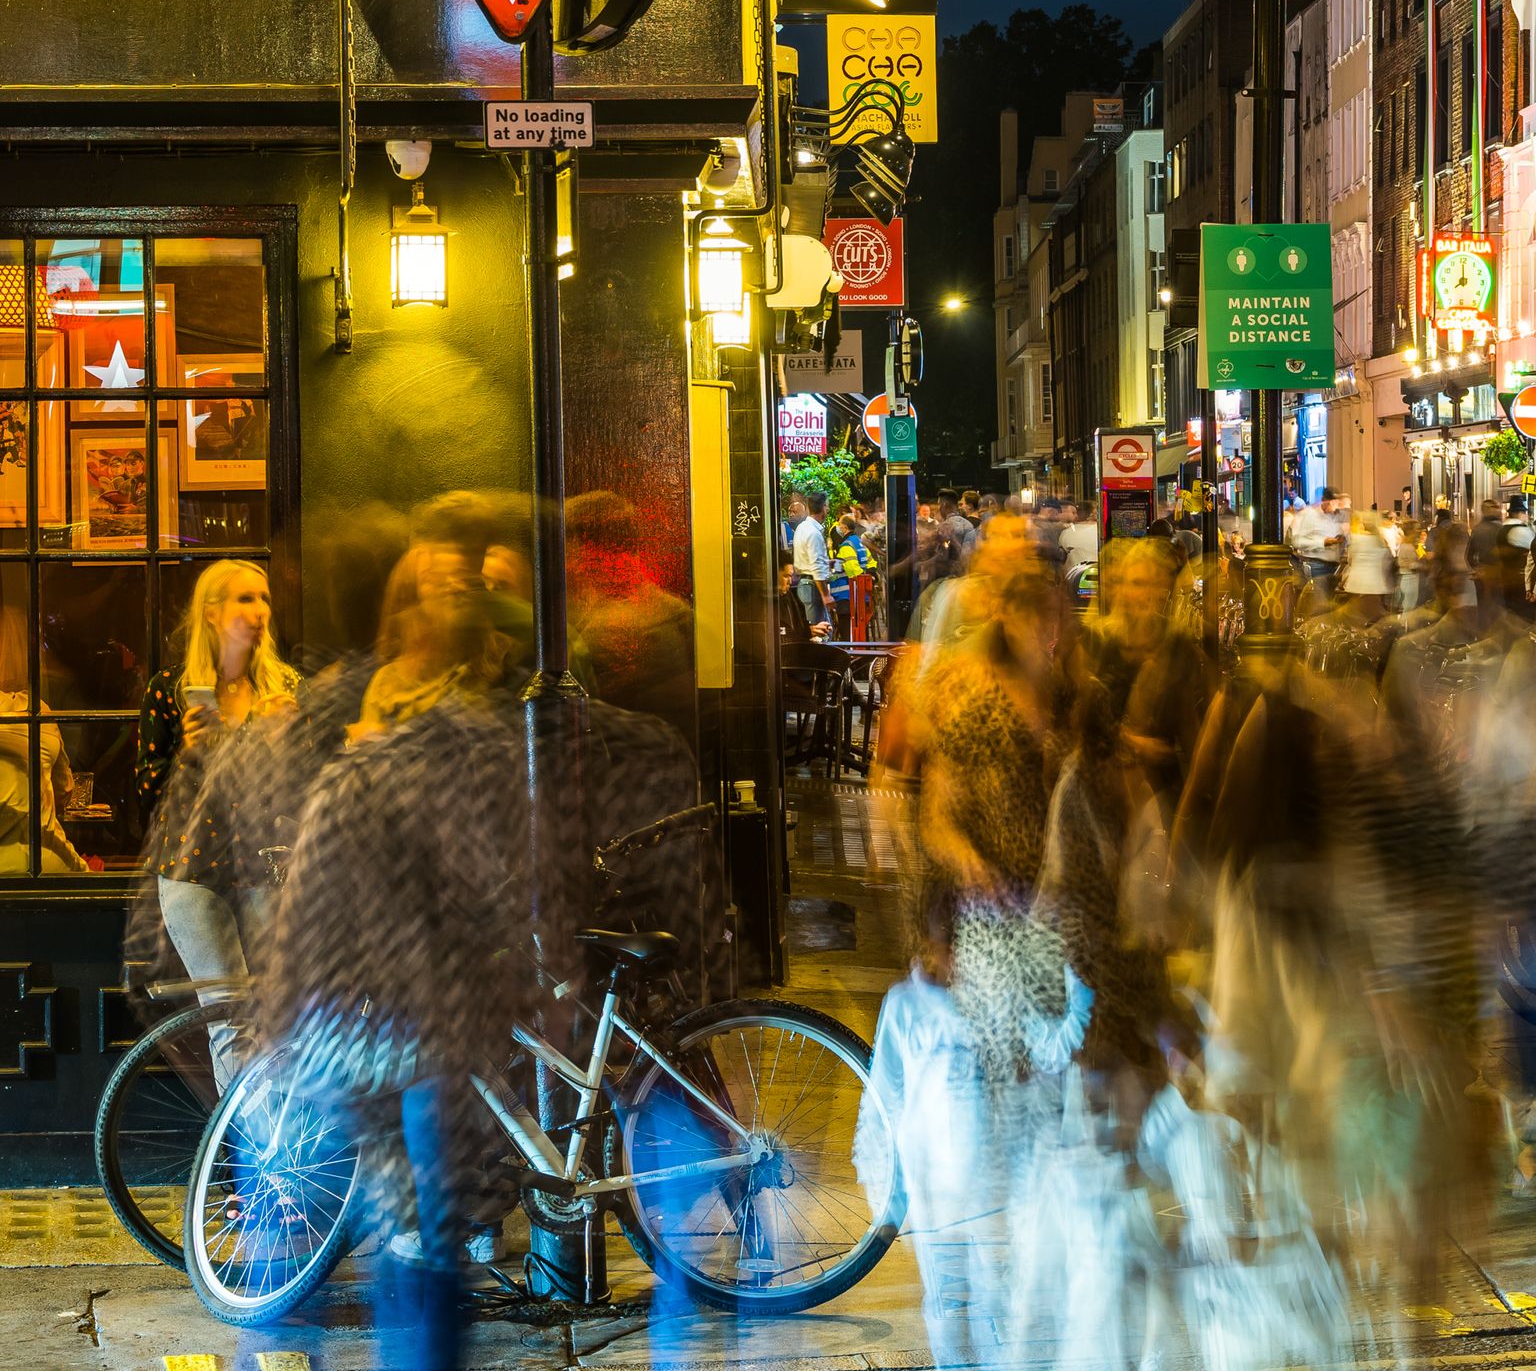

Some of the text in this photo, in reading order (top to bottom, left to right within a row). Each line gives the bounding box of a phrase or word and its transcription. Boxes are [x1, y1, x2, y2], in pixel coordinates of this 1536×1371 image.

[842, 26, 922, 52] CHA
[842, 53, 923, 80] CHA
[496, 109, 585, 124] No loading
[494, 126, 587, 142] at any time
[1436, 240, 1491, 253] BAR ITALIA
[842, 246, 878, 263] CUTS
[1228, 297, 1311, 309] MAINTAIN
[1231, 314, 1309, 326] A SOCIAL
[1229, 331, 1311, 343] DISTANCE
[788, 358, 818, 369] CAFE
[779, 411, 824, 430] Delhi
[782, 444, 822, 453] CUISINE
[1232, 461, 1242, 469] 20
